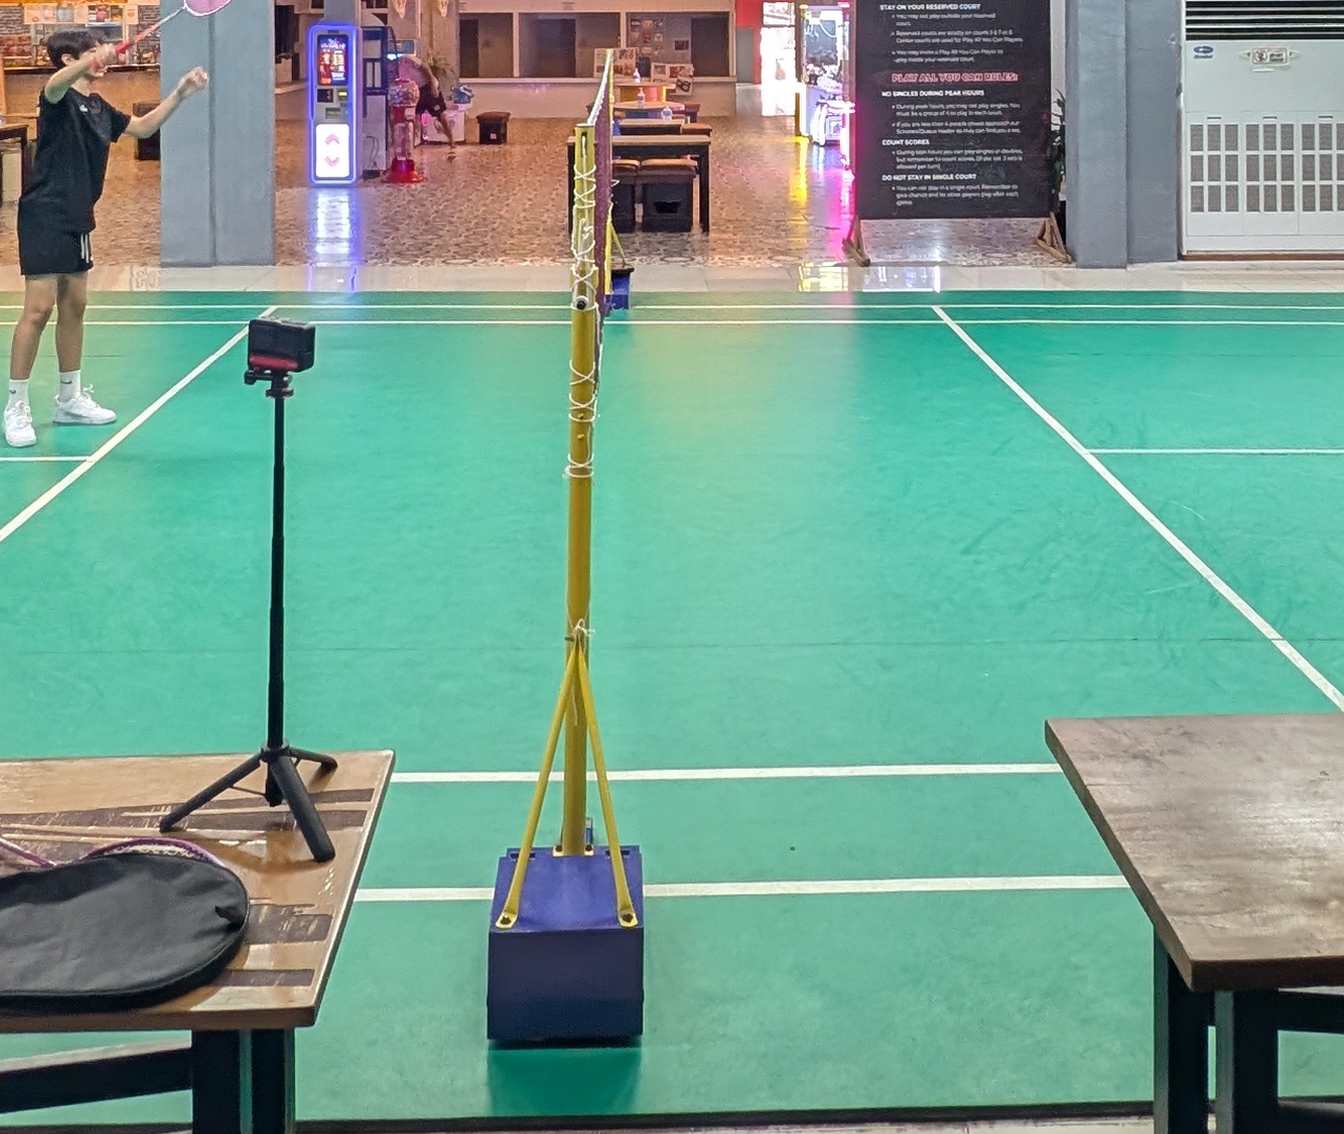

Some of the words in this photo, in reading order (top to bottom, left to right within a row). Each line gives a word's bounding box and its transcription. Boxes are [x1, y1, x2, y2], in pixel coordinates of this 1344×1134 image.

[891, 73, 918, 83] PLAY
[918, 72, 938, 83] ALL
[938, 72, 961, 82] YOU
[961, 72, 983, 82] CAN
